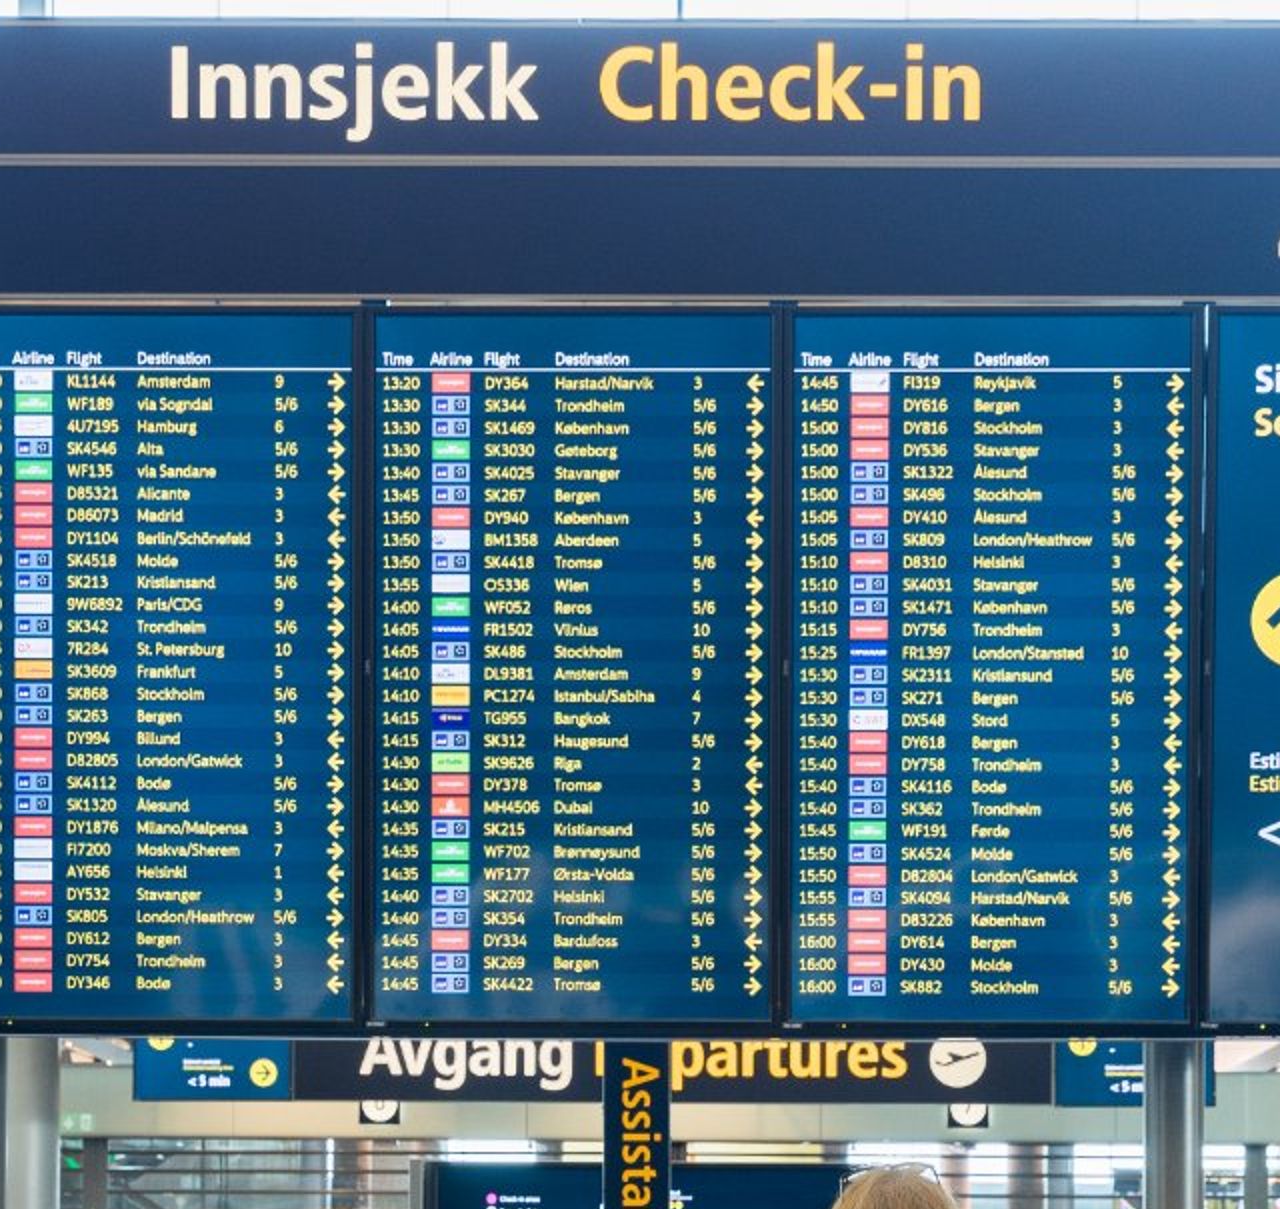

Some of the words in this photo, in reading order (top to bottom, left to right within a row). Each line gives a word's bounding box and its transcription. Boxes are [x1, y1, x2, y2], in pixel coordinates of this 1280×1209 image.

[171, 41, 538, 142] Innsjekk
[600, 41, 980, 121] Check-in
[12, 352, 54, 364] Airline
[67, 351, 101, 366] Flight
[138, 352, 210, 365] Destination
[383, 352, 413, 366] Time
[430, 352, 472, 366] Airline
[484, 352, 520, 367] Flight
[556, 352, 629, 366] Destination
[801, 352, 832, 366] Time
[848, 352, 892, 366] Airline
[904, 352, 939, 367] Flight
[975, 352, 1049, 366] Destination
[67, 374, 116, 388] KL1144
[138, 375, 210, 388] Amsterdam
[384, 376, 420, 390] 13:20
[485, 376, 528, 390] DY364
[555, 376, 653, 390] Harstad/Narvik
[68, 419, 119, 433] 4U7195
[138, 420, 197, 436] Hamburg
[384, 444, 420, 457] 13:30
[485, 444, 535, 457] SK3030
[555, 444, 617, 460] Gøteborg
[694, 443, 716, 458] 5/6
[802, 466, 838, 479] 15:00
[904, 466, 953, 479] SK1322
[974, 464, 1027, 479] Ålesund
[1113, 464, 1136, 479] 5/6
[802, 510, 838, 524] 15:05
[903, 510, 947, 524] DY410
[974, 509, 1027, 524] Ålesund
[801, 600, 838, 614] 15:10
[903, 600, 952, 614] SK1471
[974, 601, 1047, 614] København
[1112, 600, 1134, 614] 5/6
[67, 620, 108, 633] SK342
[137, 620, 206, 633] Trondheim
[275, 620, 297, 634] 5/6
[384, 623, 419, 636] 14:05
[484, 623, 532, 636] FR1502
[554, 624, 598, 636] Vilnius
[67, 664, 116, 678] SK3609
[137, 665, 195, 678] Frankfurt
[800, 668, 837, 682] 15:30
[902, 668, 951, 682] SK2311
[973, 669, 1052, 682] Kristiansund
[1112, 668, 1134, 682] 5/6
[384, 689, 420, 702] 14:10
[484, 689, 534, 702] PC1274
[555, 689, 655, 703] Istanbul/Sabiha
[67, 731, 110, 744] DY994
[137, 731, 180, 745] Billund
[383, 734, 418, 747] 14:15
[484, 734, 525, 747] SK312
[554, 735, 628, 750] Haugesund
[692, 734, 715, 748] 5/6
[800, 824, 836, 837] 15:45
[902, 824, 947, 837] WF191
[972, 824, 1010, 838] Førde
[1110, 824, 1133, 838] 5/6
[383, 845, 418, 858] 14:35
[484, 845, 530, 859] WF702
[692, 845, 715, 859] 5/6
[800, 847, 836, 860] 15:50
[902, 847, 951, 860] SK4524
[971, 848, 1013, 861] Molde
[1110, 847, 1133, 861] 5/6
[67, 954, 110, 966] DY754
[137, 954, 205, 968] Trondheim
[360, 1038, 572, 1090] Avgang
[595, 1040, 910, 1091] partures
[208, 1073, 231, 1087] min
